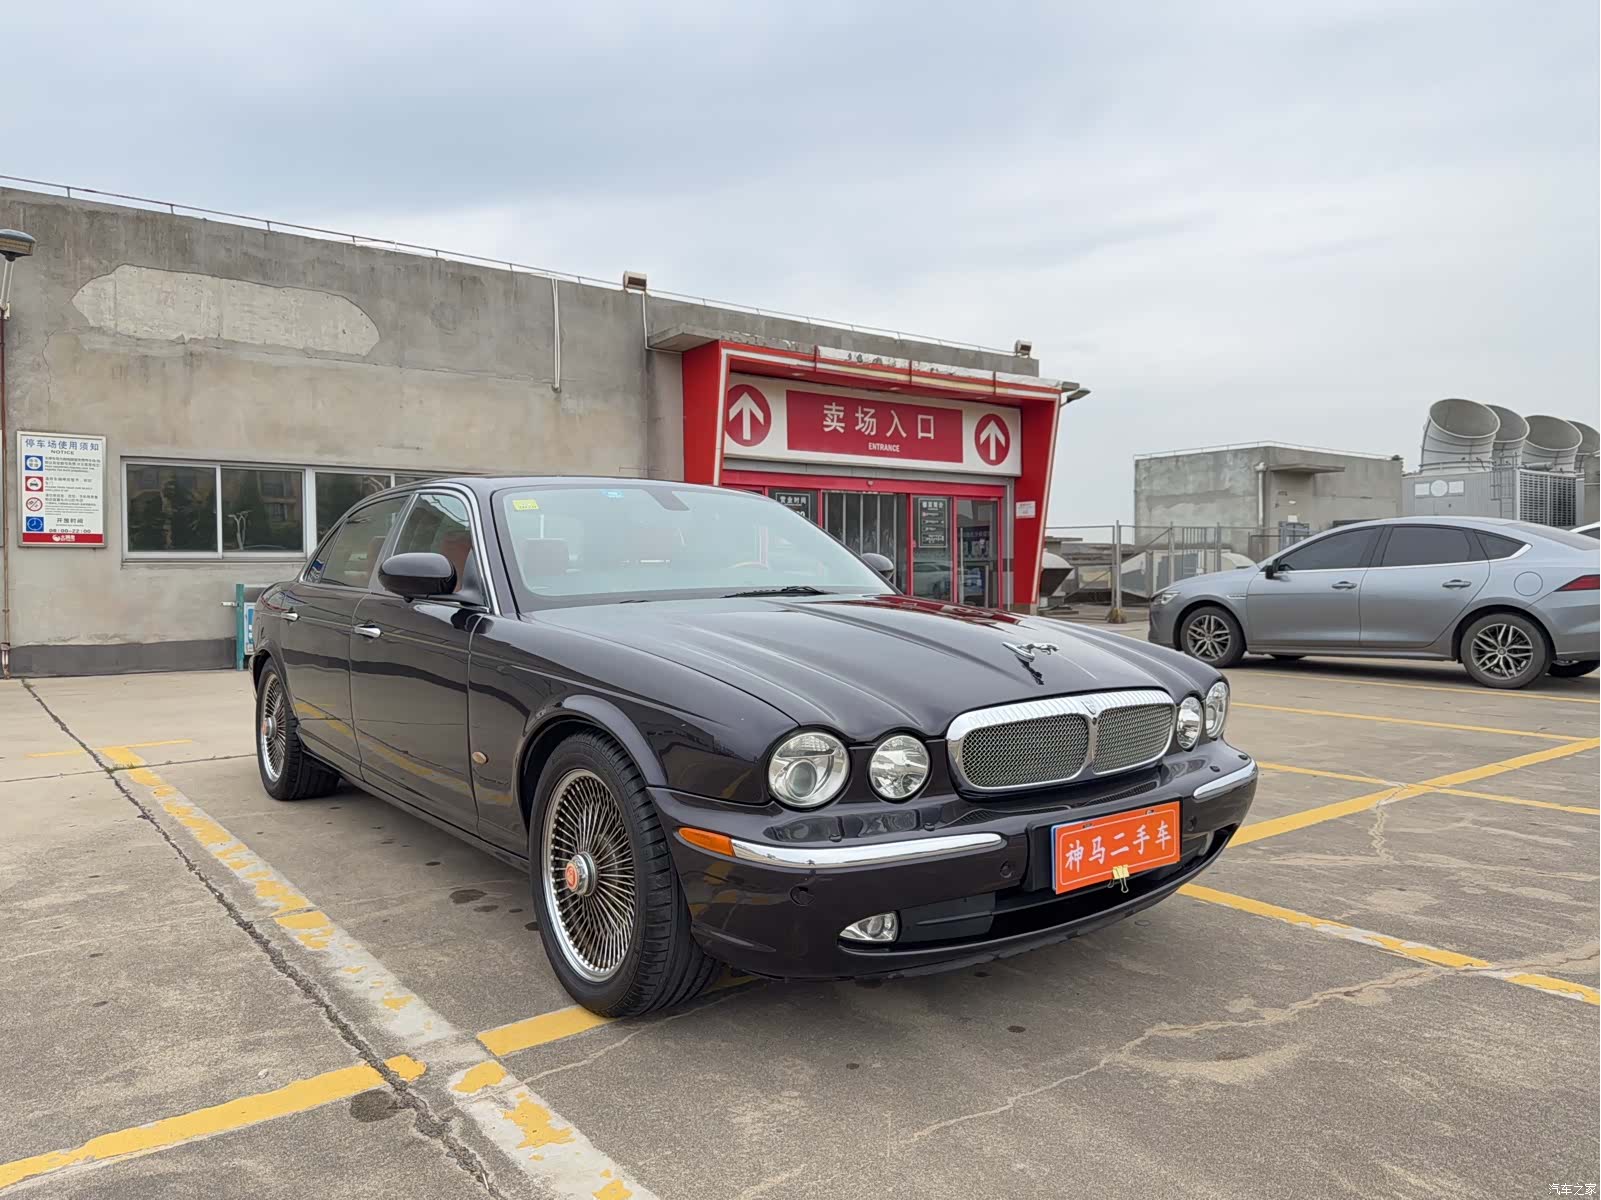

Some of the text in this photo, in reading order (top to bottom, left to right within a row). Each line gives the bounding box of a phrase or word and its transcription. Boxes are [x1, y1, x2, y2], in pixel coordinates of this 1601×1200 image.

[822, 402, 935, 440] 卖场入口
[25, 438, 99, 451] 停车场使用须知
[868, 442, 900, 453] ENTRANCE
[1064, 820, 1172, 873] 神马二手车
